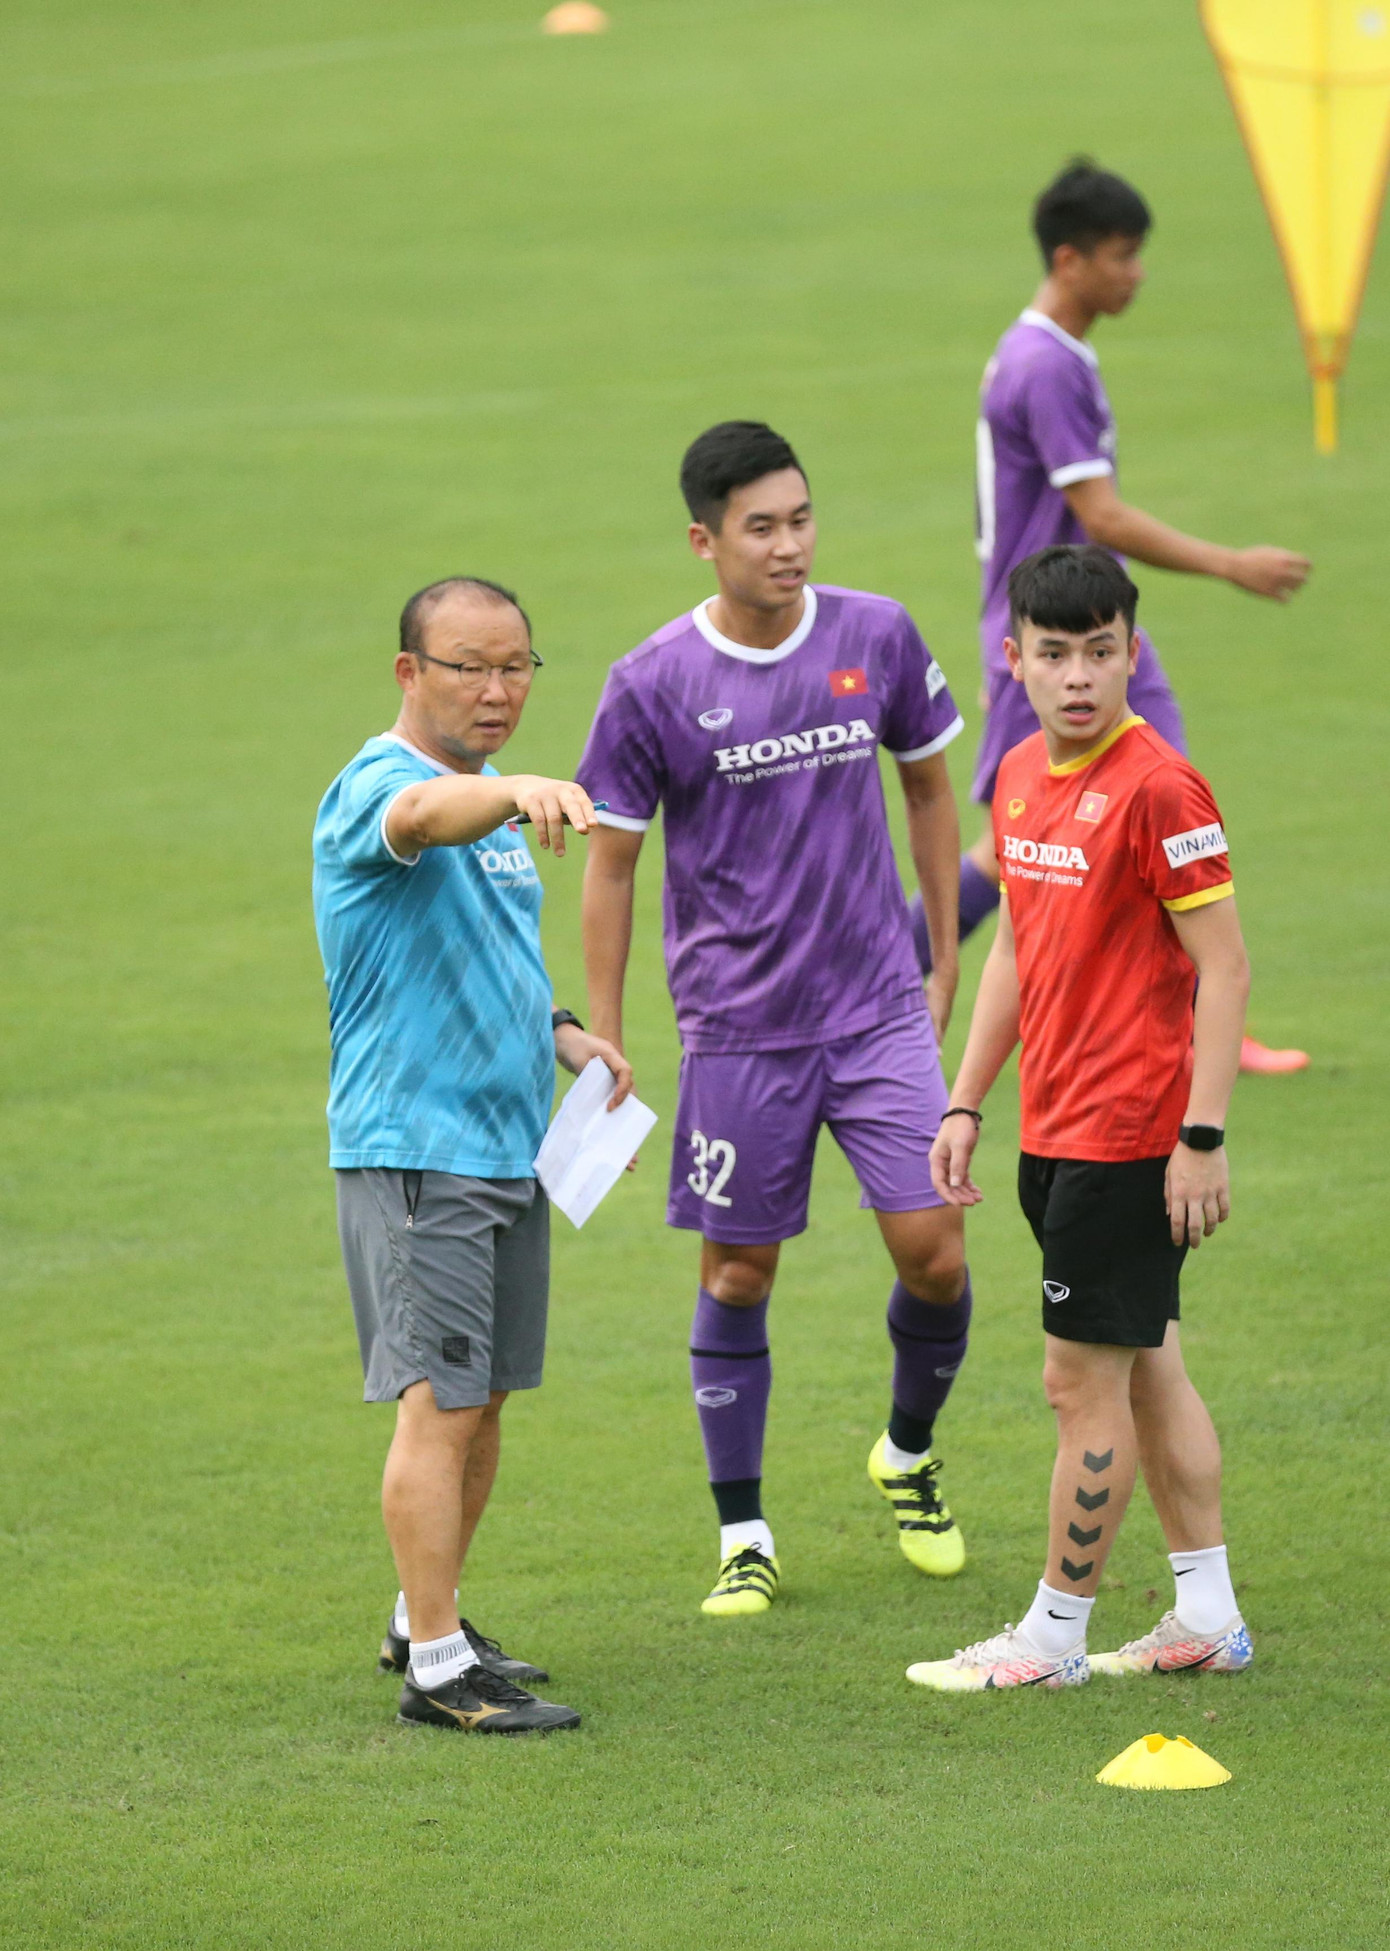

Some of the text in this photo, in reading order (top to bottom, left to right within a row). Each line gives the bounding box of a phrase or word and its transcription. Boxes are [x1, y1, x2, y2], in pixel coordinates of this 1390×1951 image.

[714, 719, 875, 771] HONDA
[724, 747, 872, 785] The Power of Dreams
[475, 848, 534, 873] OND
[1003, 835, 1089, 870] HONDA
[1016, 865, 1044, 882] Power
[687, 1129, 736, 1207] 32
